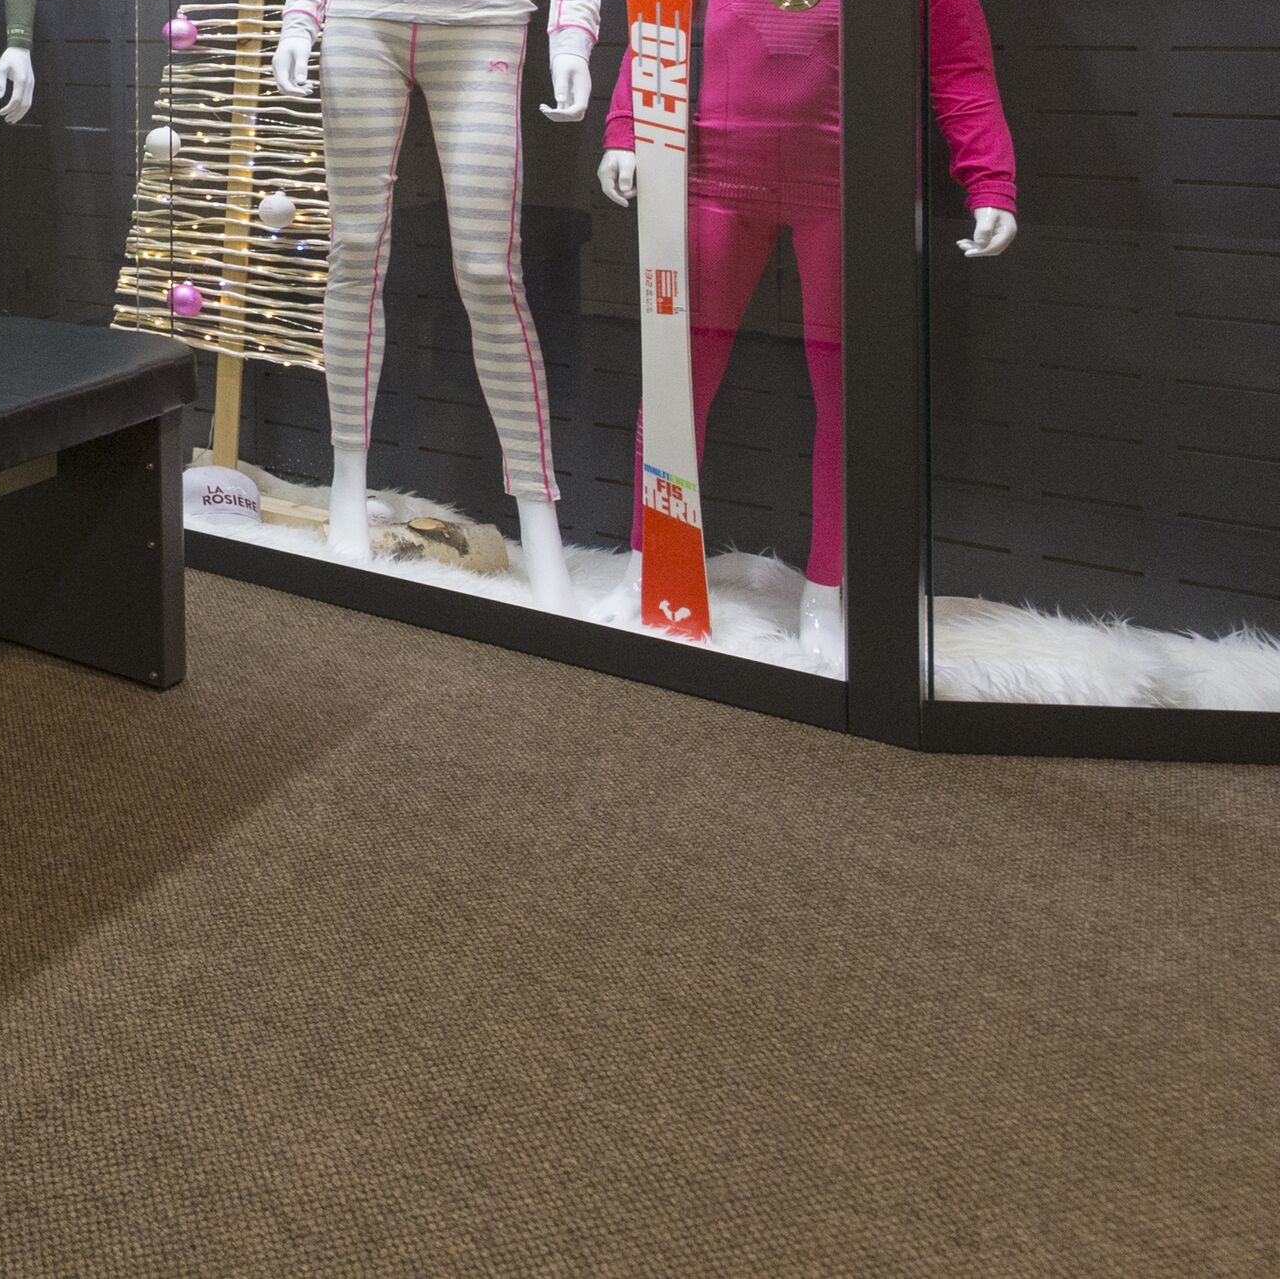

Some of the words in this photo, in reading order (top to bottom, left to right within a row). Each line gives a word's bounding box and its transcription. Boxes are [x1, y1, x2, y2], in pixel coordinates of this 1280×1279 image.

[631, 21, 688, 154] HERO
[206, 485, 224, 494] LA
[656, 477, 683, 501] FIS
[643, 484, 702, 529] HERO
